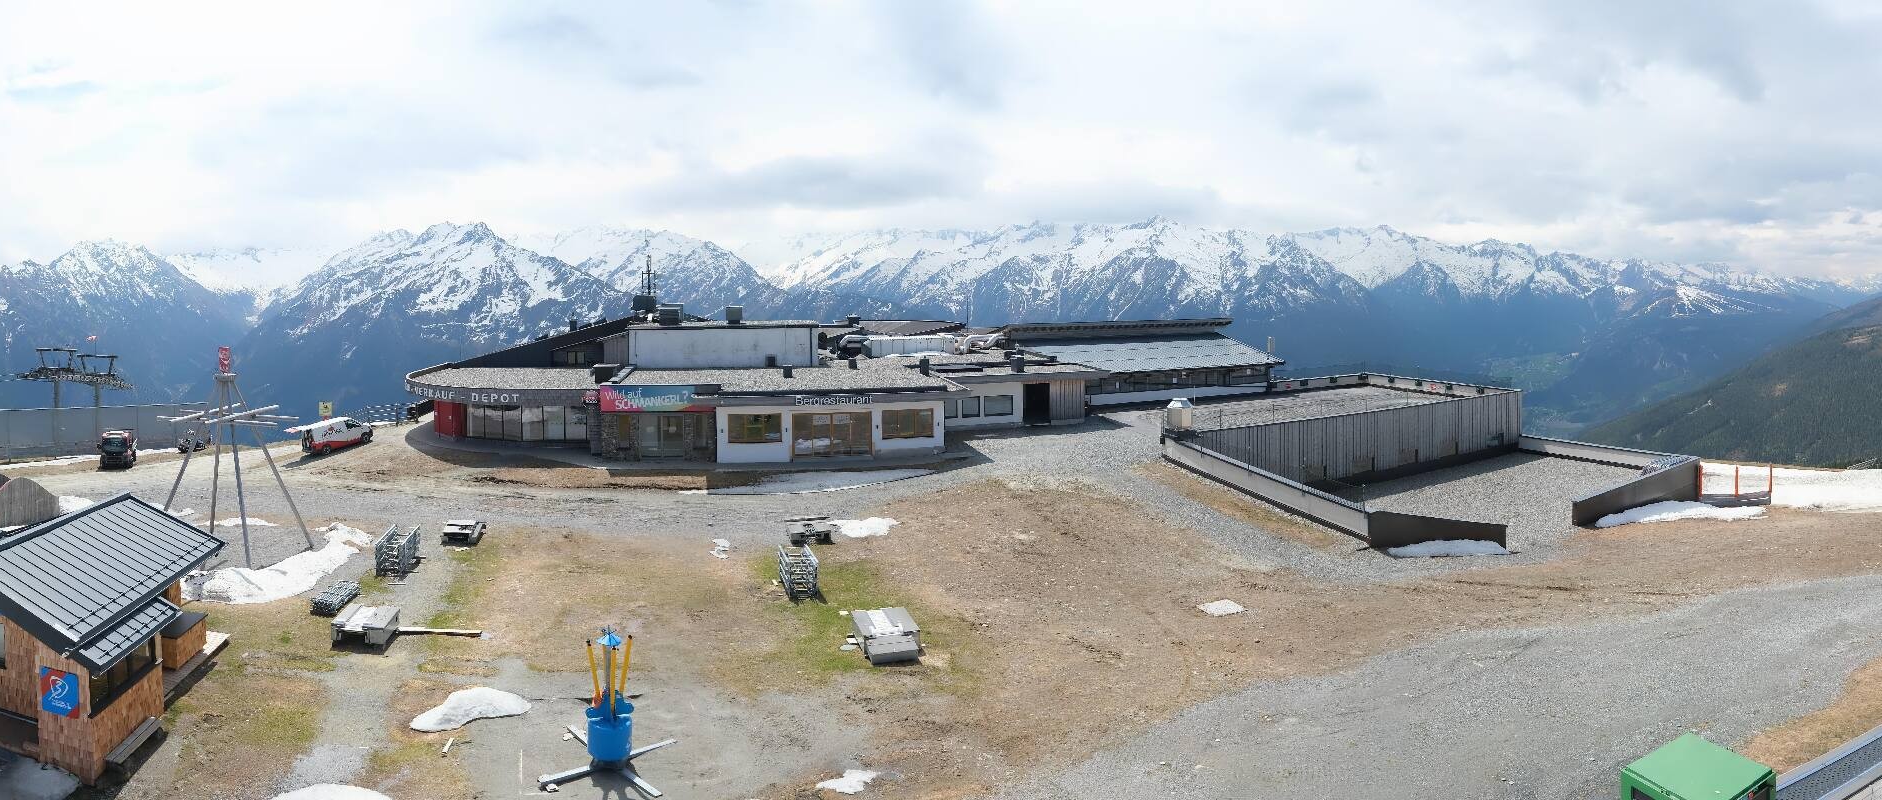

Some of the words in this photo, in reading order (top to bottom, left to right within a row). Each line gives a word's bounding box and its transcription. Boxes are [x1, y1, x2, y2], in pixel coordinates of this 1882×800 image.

[415, 386, 455, 400] VERKAUF
[471, 392, 520, 403] DEPOT
[605, 389, 624, 401] Wild
[627, 387, 643, 398] auf
[615, 390, 689, 410] SCHMANKERL?
[795, 395, 874, 406] Bergrestaurant
